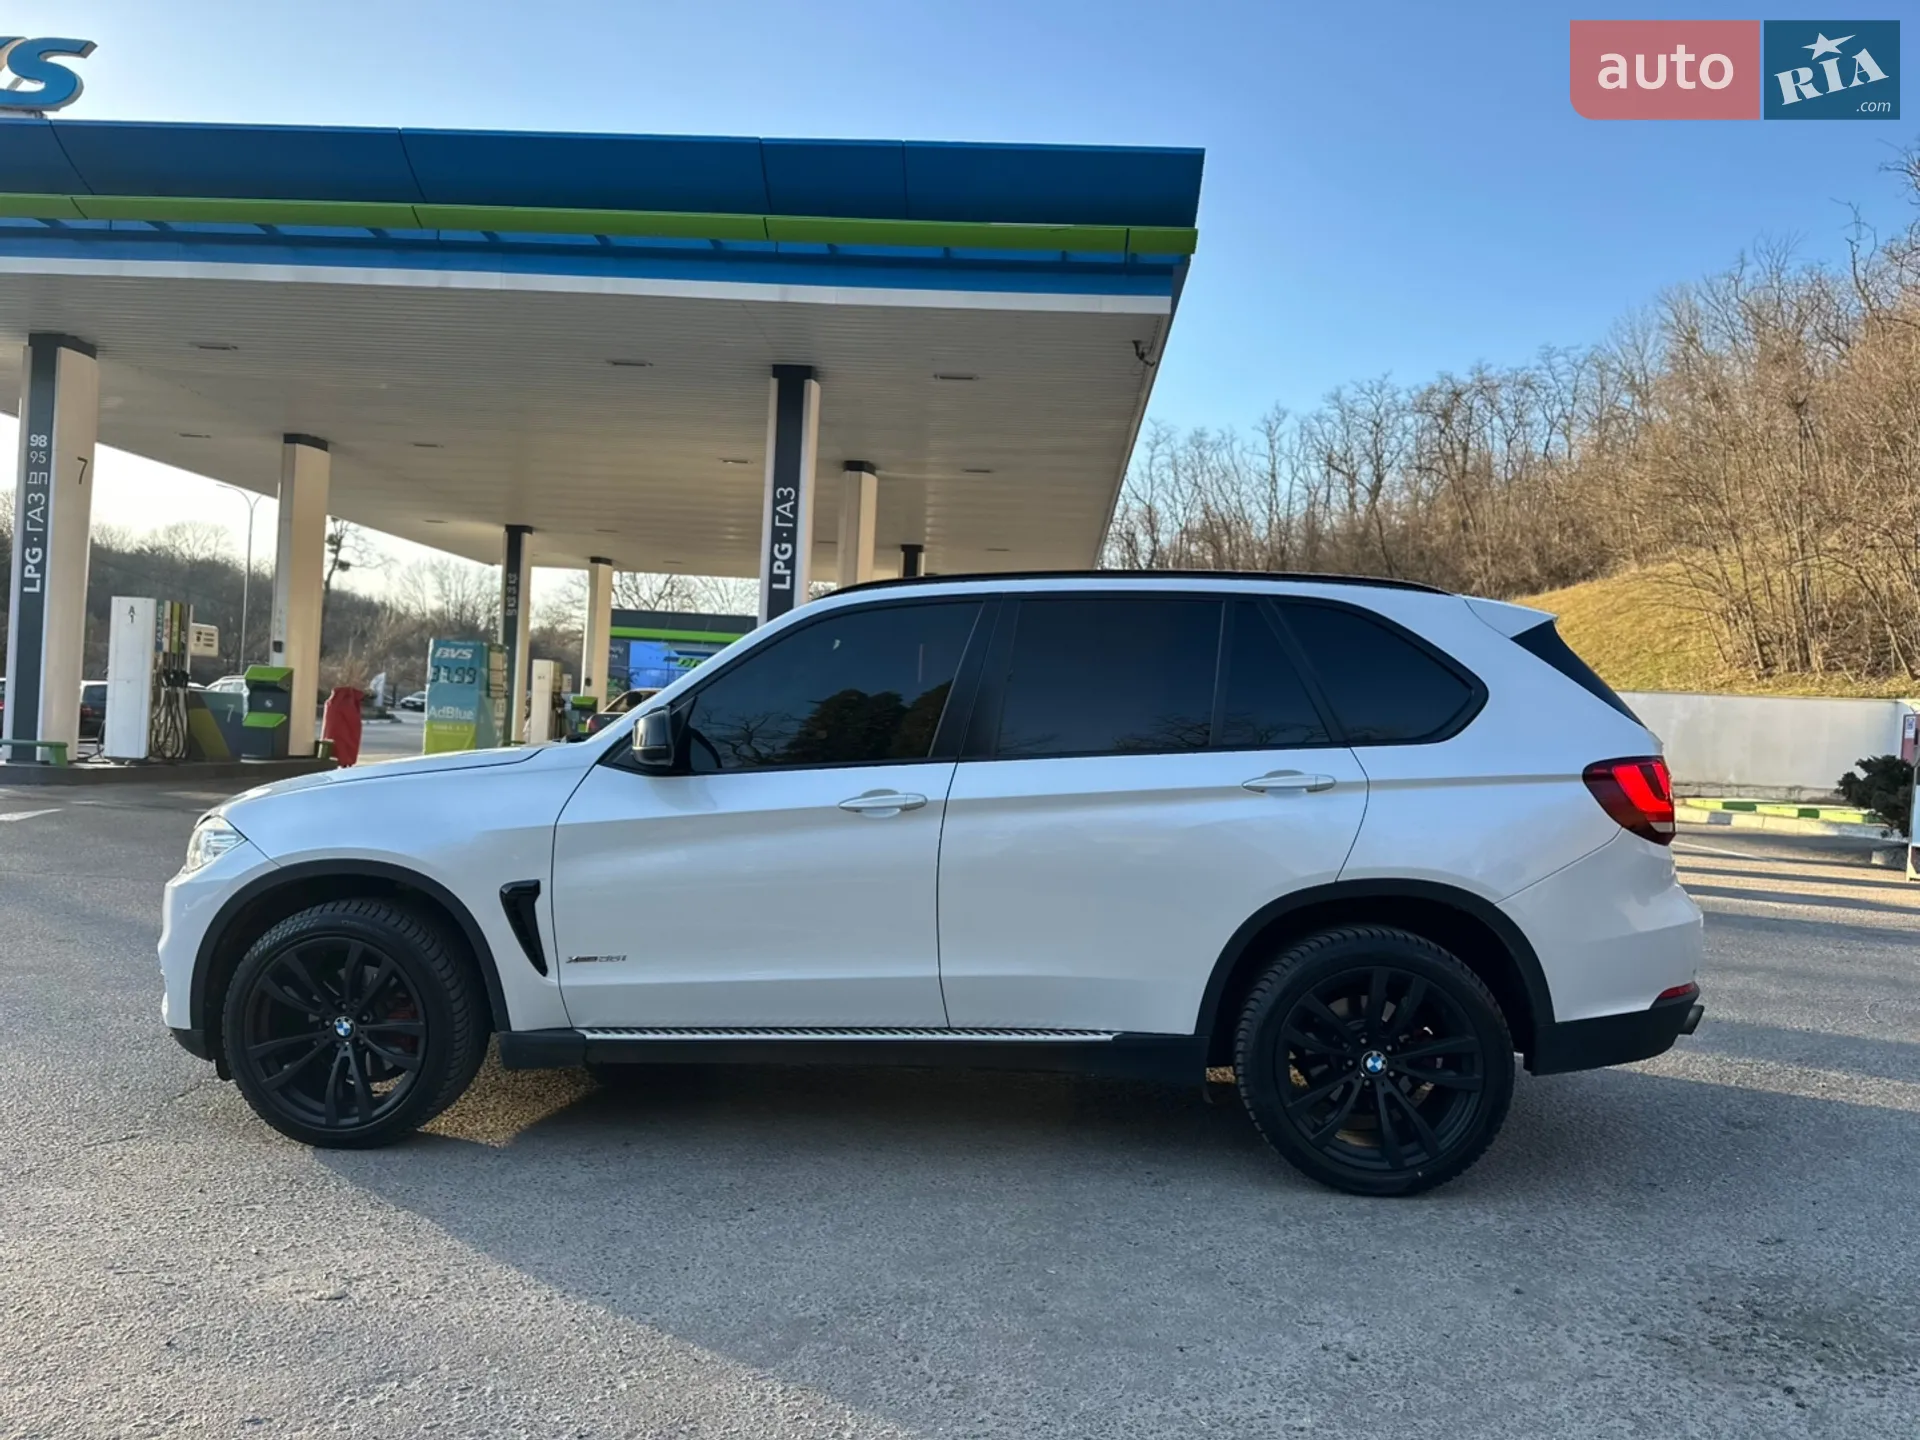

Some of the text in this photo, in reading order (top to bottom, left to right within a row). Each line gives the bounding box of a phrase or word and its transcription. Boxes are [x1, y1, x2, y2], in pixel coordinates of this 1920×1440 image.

[0, 37, 98, 111] S
[29, 434, 48, 447] 98
[29, 450, 47, 464] 95
[27, 471, 48, 485] ДП
[77, 456, 89, 485] 7
[23, 492, 46, 593] LPG ГАЗ
[772, 487, 796, 590] LPG ГАЗ
[435, 647, 474, 659] BVS
[227, 704, 235, 723] 7
[428, 706, 475, 720] AdBlue
